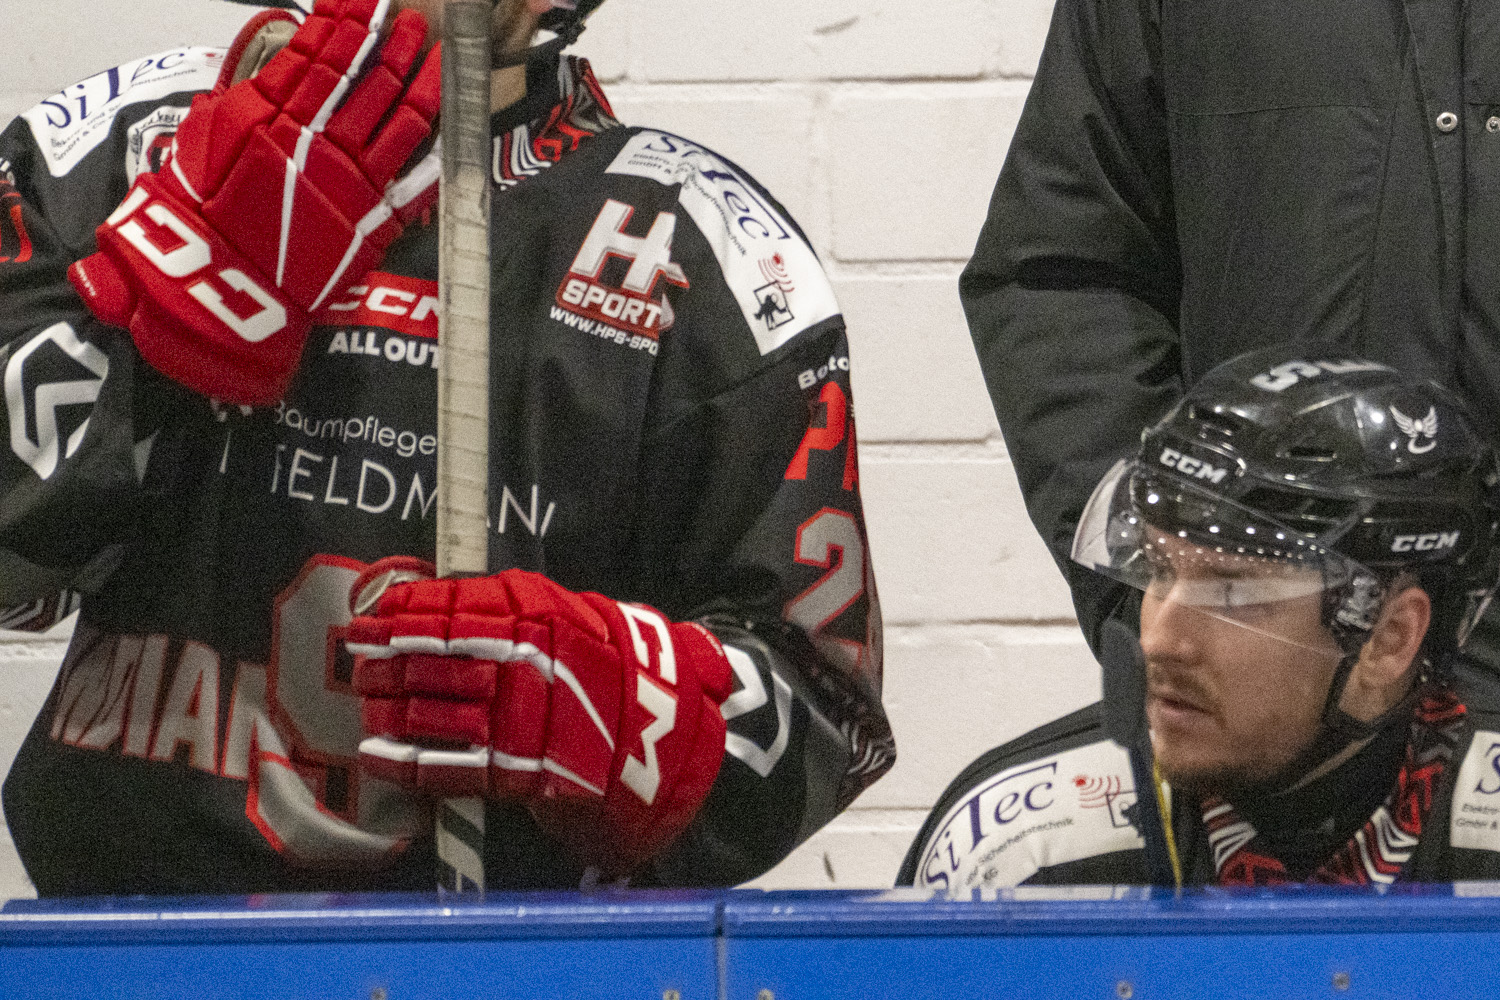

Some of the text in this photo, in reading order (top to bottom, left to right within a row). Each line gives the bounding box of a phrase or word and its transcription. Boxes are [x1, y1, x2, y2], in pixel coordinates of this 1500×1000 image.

[562, 279, 661, 329] SPORT
[328, 331, 380, 356] ALL
[550, 305, 659, 357] WWW.HPS-SPO
[798, 355, 850, 390] Beto
[1160, 447, 1227, 484] CCM
[1391, 530, 1459, 552] CCM
[920, 762, 1058, 887] SiTec
